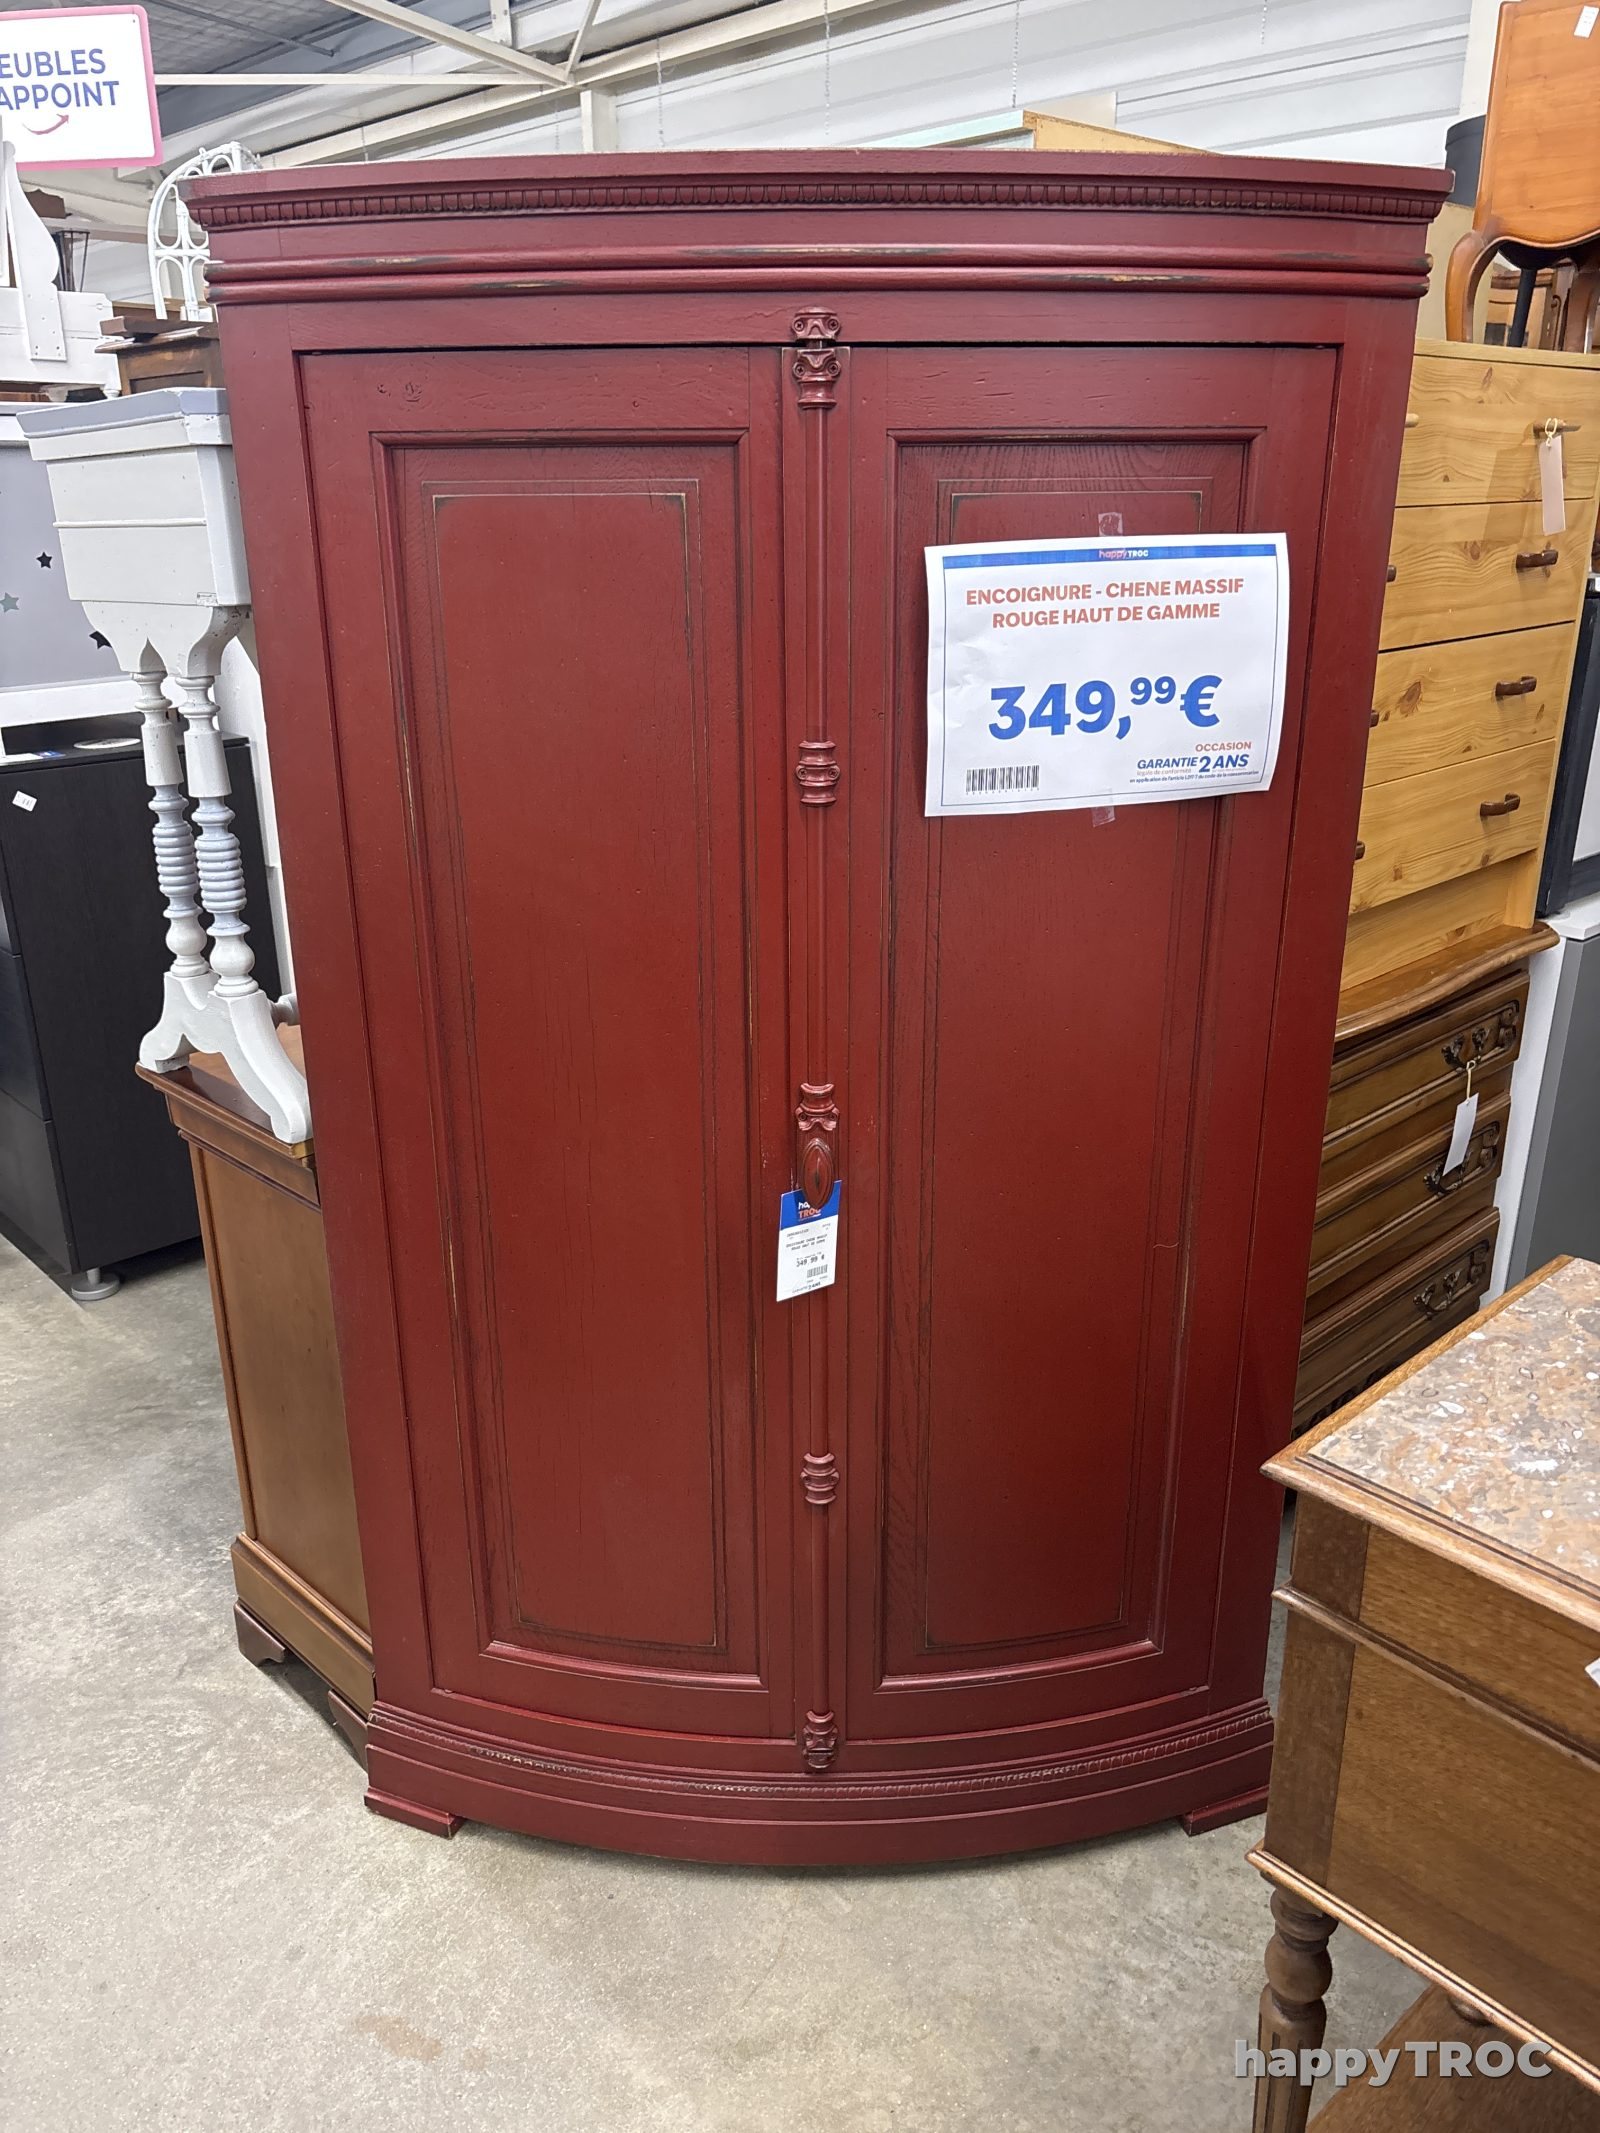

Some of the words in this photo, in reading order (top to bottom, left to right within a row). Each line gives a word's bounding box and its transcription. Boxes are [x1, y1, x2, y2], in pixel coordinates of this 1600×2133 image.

[966, 584, 1092, 605] ENCOIGNURE
[1105, 581, 1171, 598] CHENE
[1174, 578, 1244, 595] MASSIF
[992, 610, 1060, 628] ROUGE
[1063, 607, 1114, 624] HAUT
[1117, 606, 1143, 621] DE
[1146, 603, 1221, 620] GAMME
[1195, 741, 1252, 752] OCCASION
[1137, 756, 1199, 770] GARANTIE
[1198, 755, 1211, 773] 2
[1212, 753, 1250, 769] ANS
